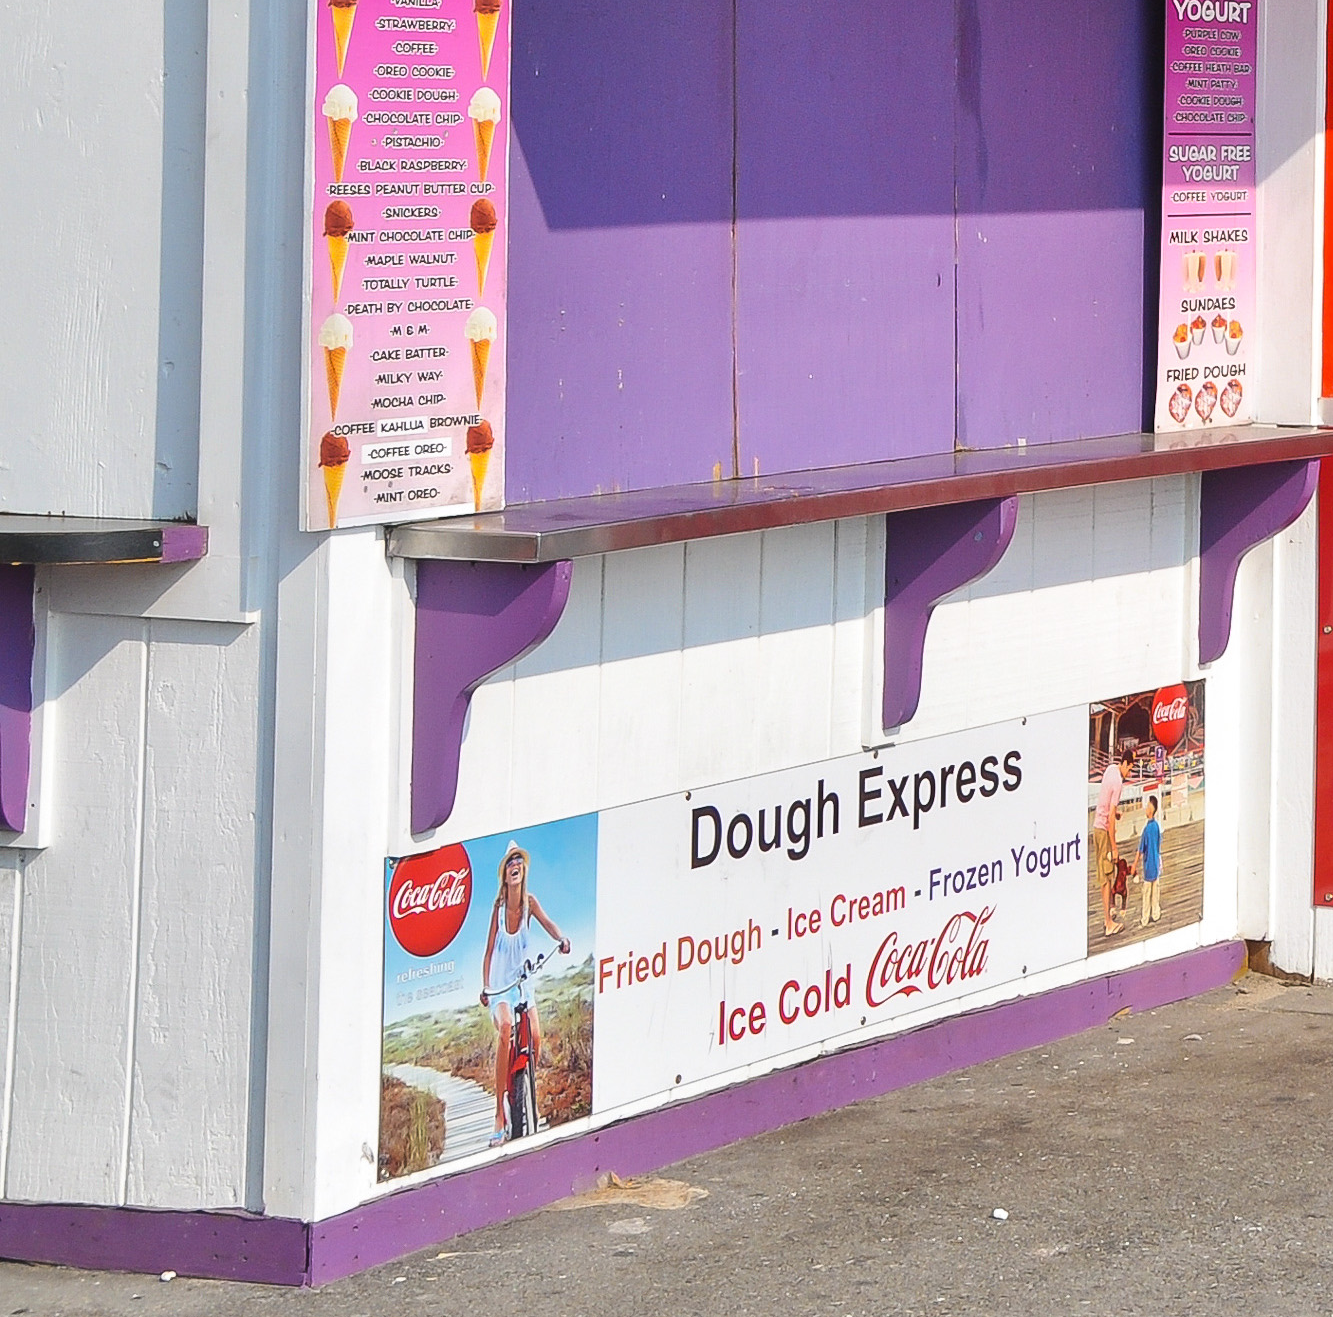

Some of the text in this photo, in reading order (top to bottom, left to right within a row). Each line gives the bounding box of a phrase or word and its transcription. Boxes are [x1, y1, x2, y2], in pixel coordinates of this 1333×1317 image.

[1173, 0, 1251, 24] YOGURT
[1169, 145, 1251, 162] SUGAR FREE
[1182, 165, 1239, 182] YOGURT
[375, 184, 465, 195] PEANUT BUTTER
[1169, 229, 1248, 243] MILK SHAKES
[1181, 298, 1236, 312] SUNDAES
[1167, 363, 1246, 382] FRIED DOUGH
[691, 750, 1024, 870] Dough Express
[393, 868, 469, 918] Coca-Cola
[598, 833, 1082, 994] Fried Dough Ice Cream Frozen Yogurt
[719, 903, 998, 1046] Ice Cold Coca-Cola
